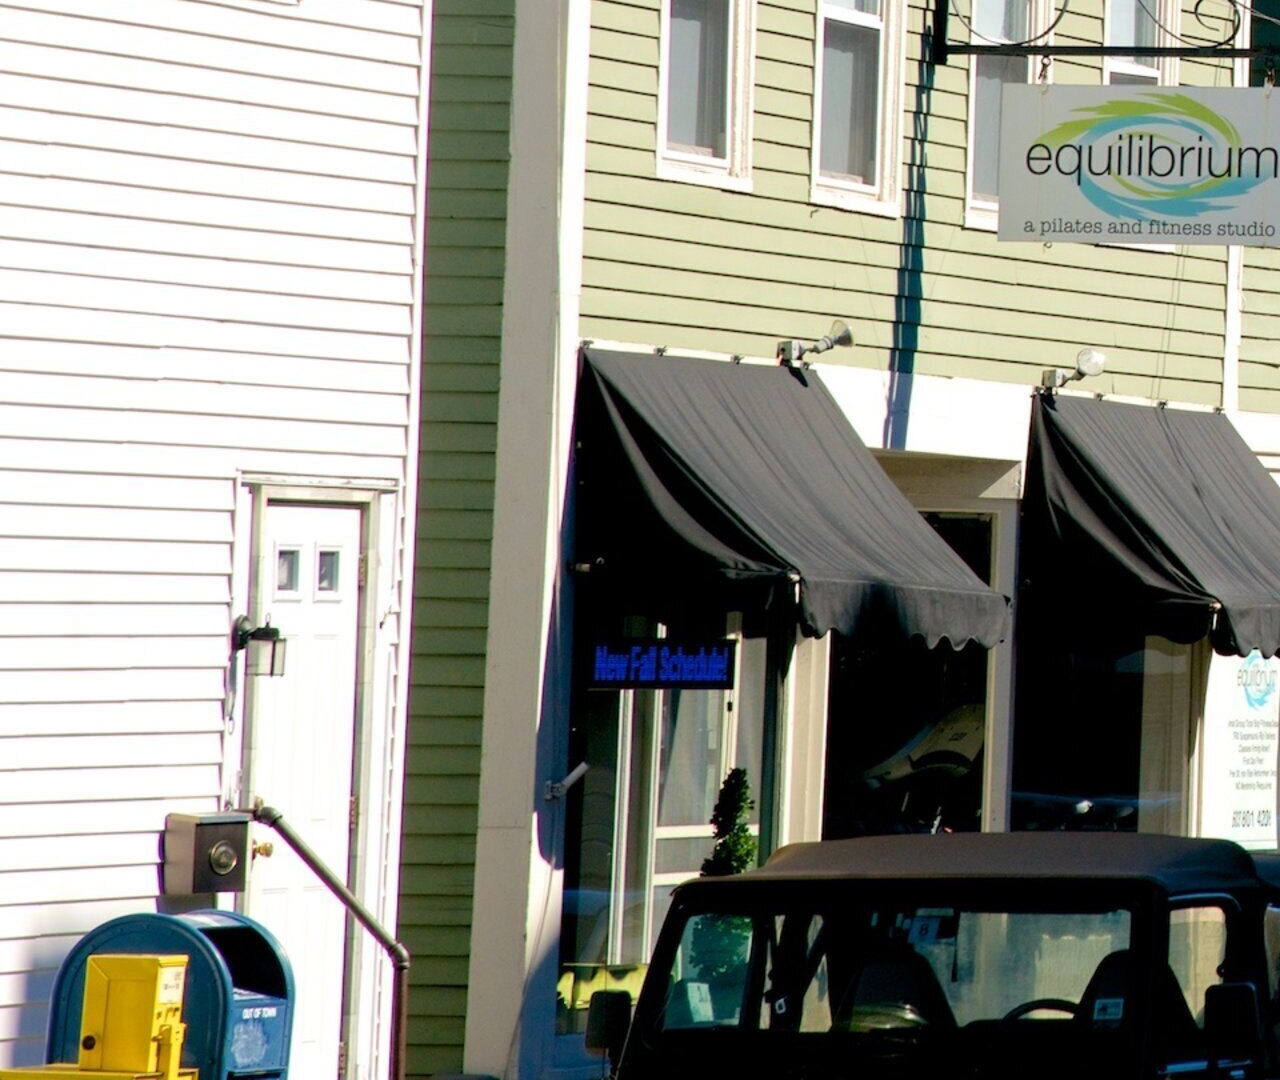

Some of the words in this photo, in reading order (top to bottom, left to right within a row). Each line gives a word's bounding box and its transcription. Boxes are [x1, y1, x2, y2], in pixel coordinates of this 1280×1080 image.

[1026, 134, 1279, 186] equilibrium
[1023, 220, 1035, 234] a
[1040, 218, 1102, 237] pilates
[1107, 219, 1143, 235] and
[1148, 219, 1212, 237] fitness
[1216, 220, 1276, 238] studio
[594, 645, 629, 681] New
[631, 645, 656, 681] Fall
